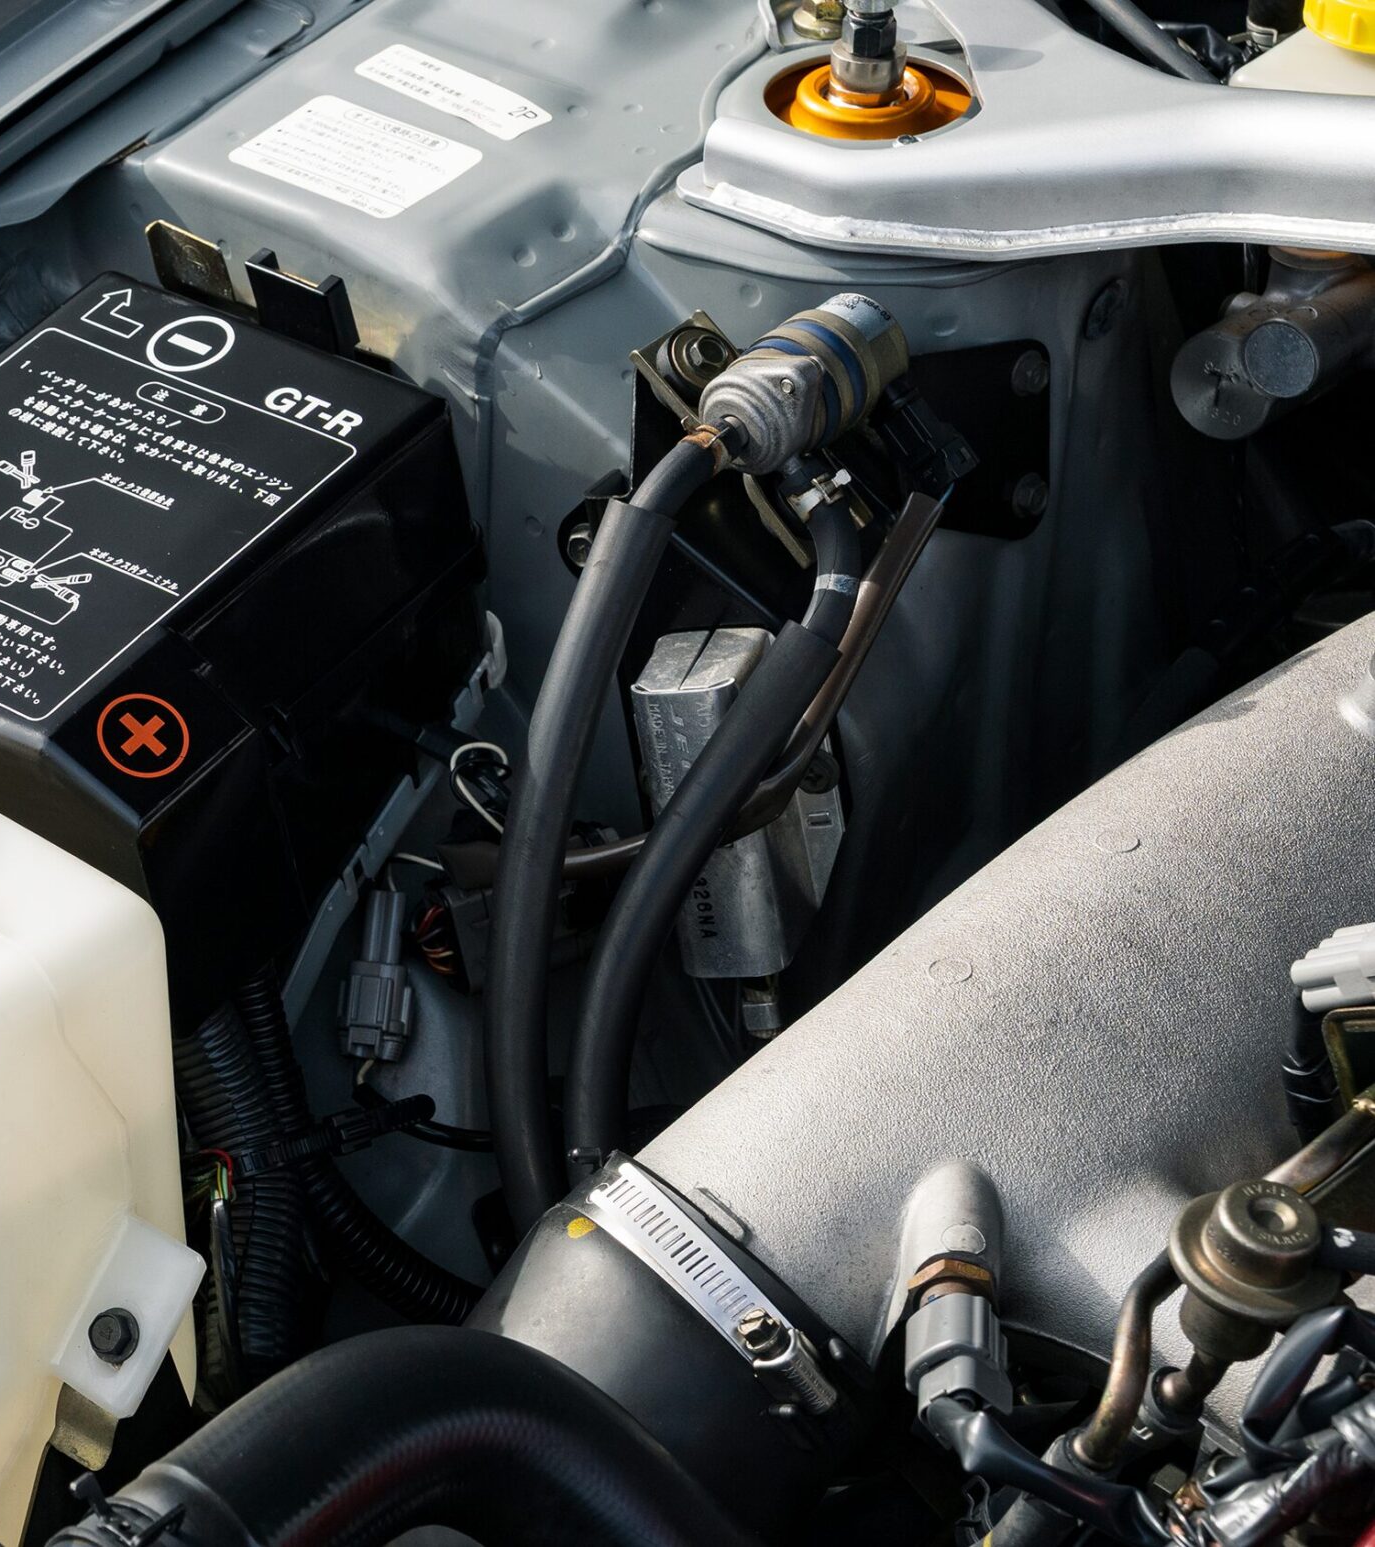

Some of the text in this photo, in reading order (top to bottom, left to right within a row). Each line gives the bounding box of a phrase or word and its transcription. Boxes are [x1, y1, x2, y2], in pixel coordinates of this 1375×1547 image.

[508, 106, 537, 121] 2P
[265, 385, 363, 436] GT-R
[650, 703, 666, 735] MADE
